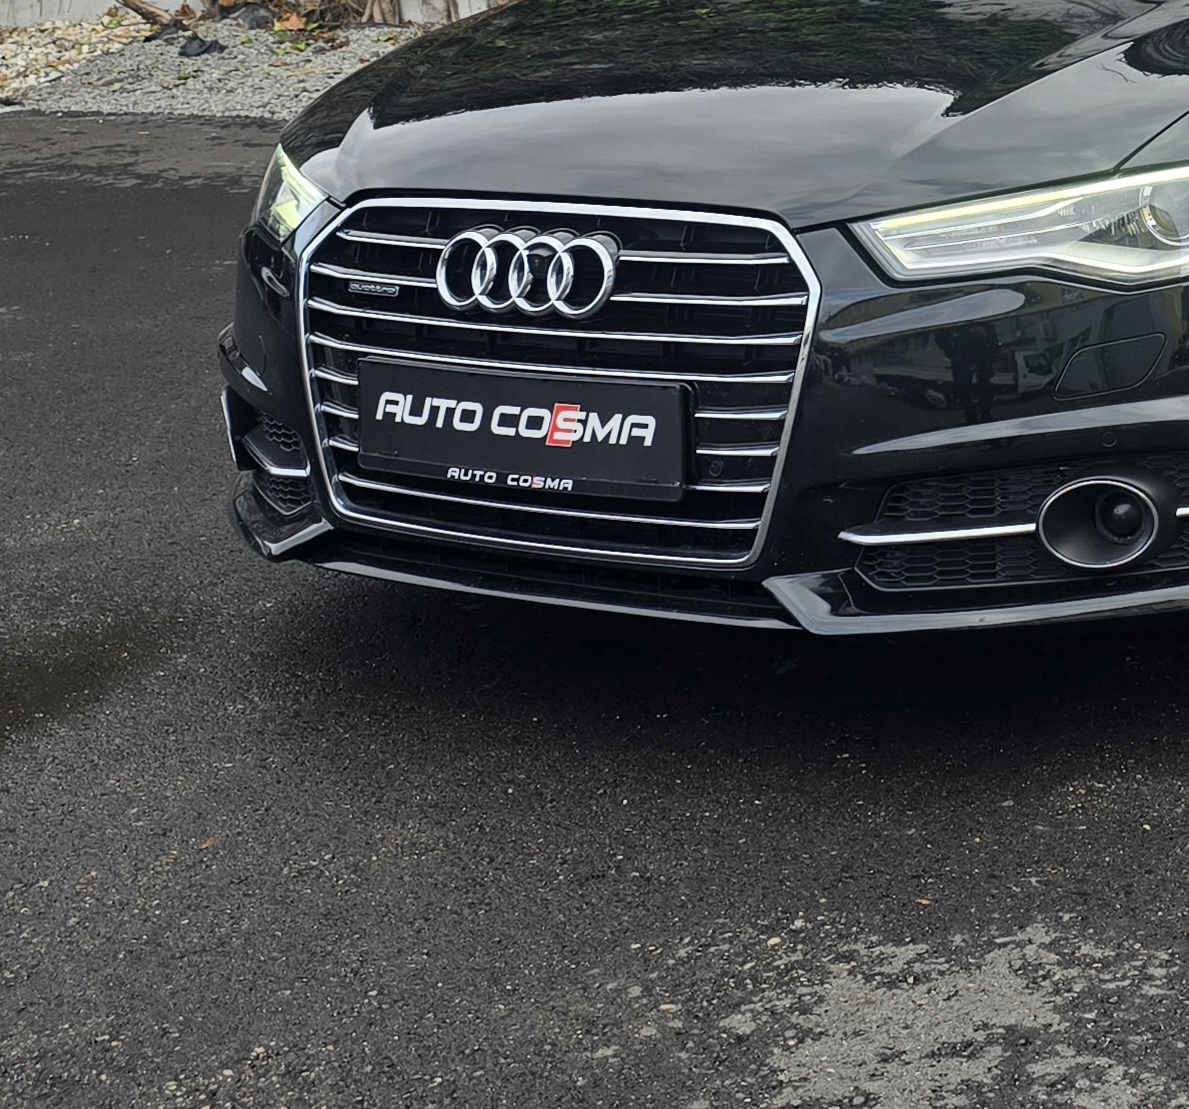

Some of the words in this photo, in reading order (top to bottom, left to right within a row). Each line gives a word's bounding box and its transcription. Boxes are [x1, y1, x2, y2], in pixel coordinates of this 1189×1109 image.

[375, 391, 484, 432] AUTO
[490, 404, 657, 447] COSMA
[446, 467, 497, 484] AUTO
[506, 473, 574, 491] COSMA
